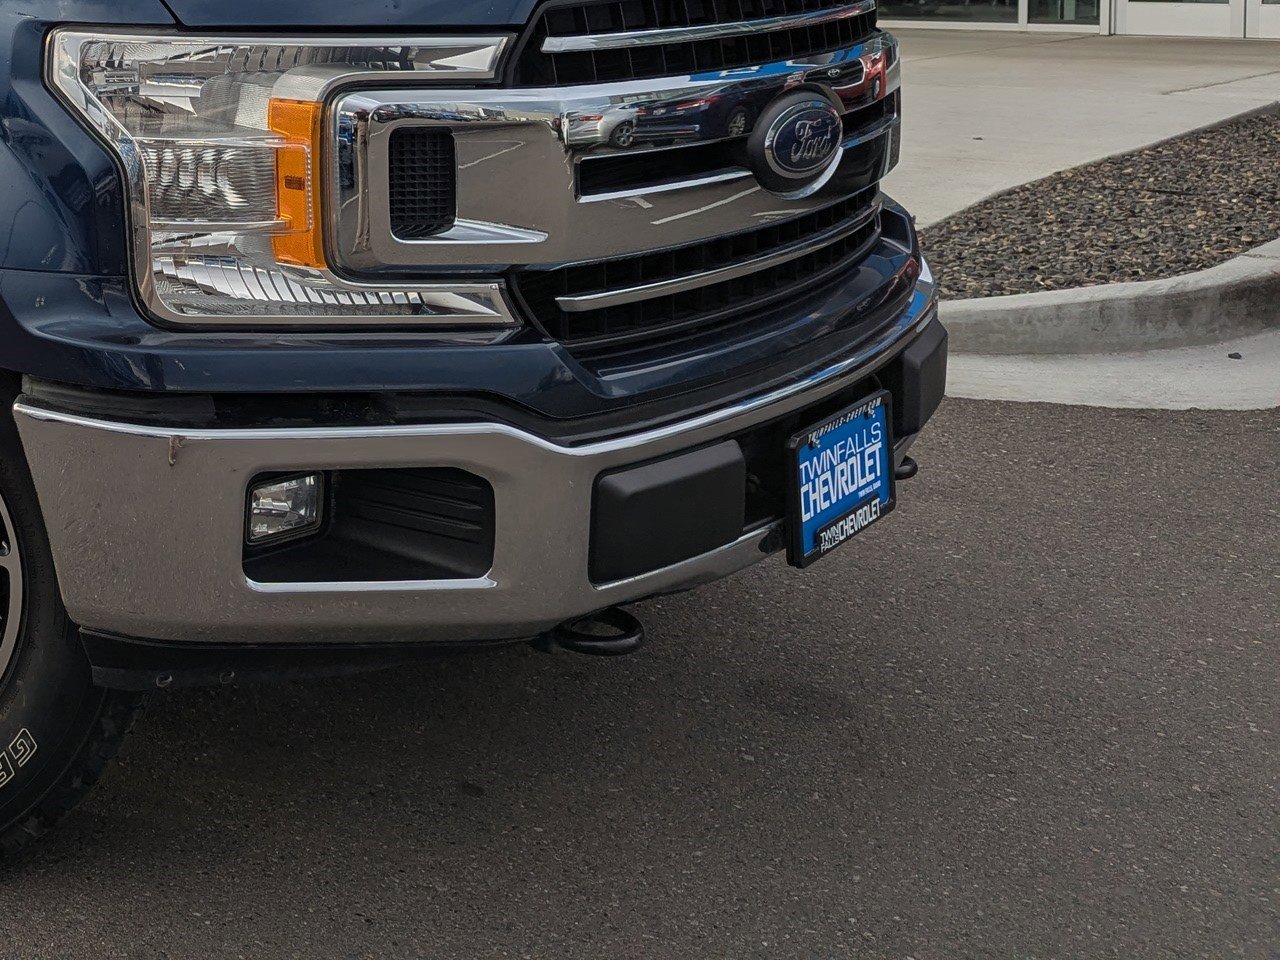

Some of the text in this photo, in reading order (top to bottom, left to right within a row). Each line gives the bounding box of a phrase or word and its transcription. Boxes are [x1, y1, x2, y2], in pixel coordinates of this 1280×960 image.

[790, 118, 832, 163] Ford
[799, 421, 882, 485] TWINFALLS
[800, 442, 882, 523] CHEVROLET
[838, 497, 881, 541] CHEVROLET
